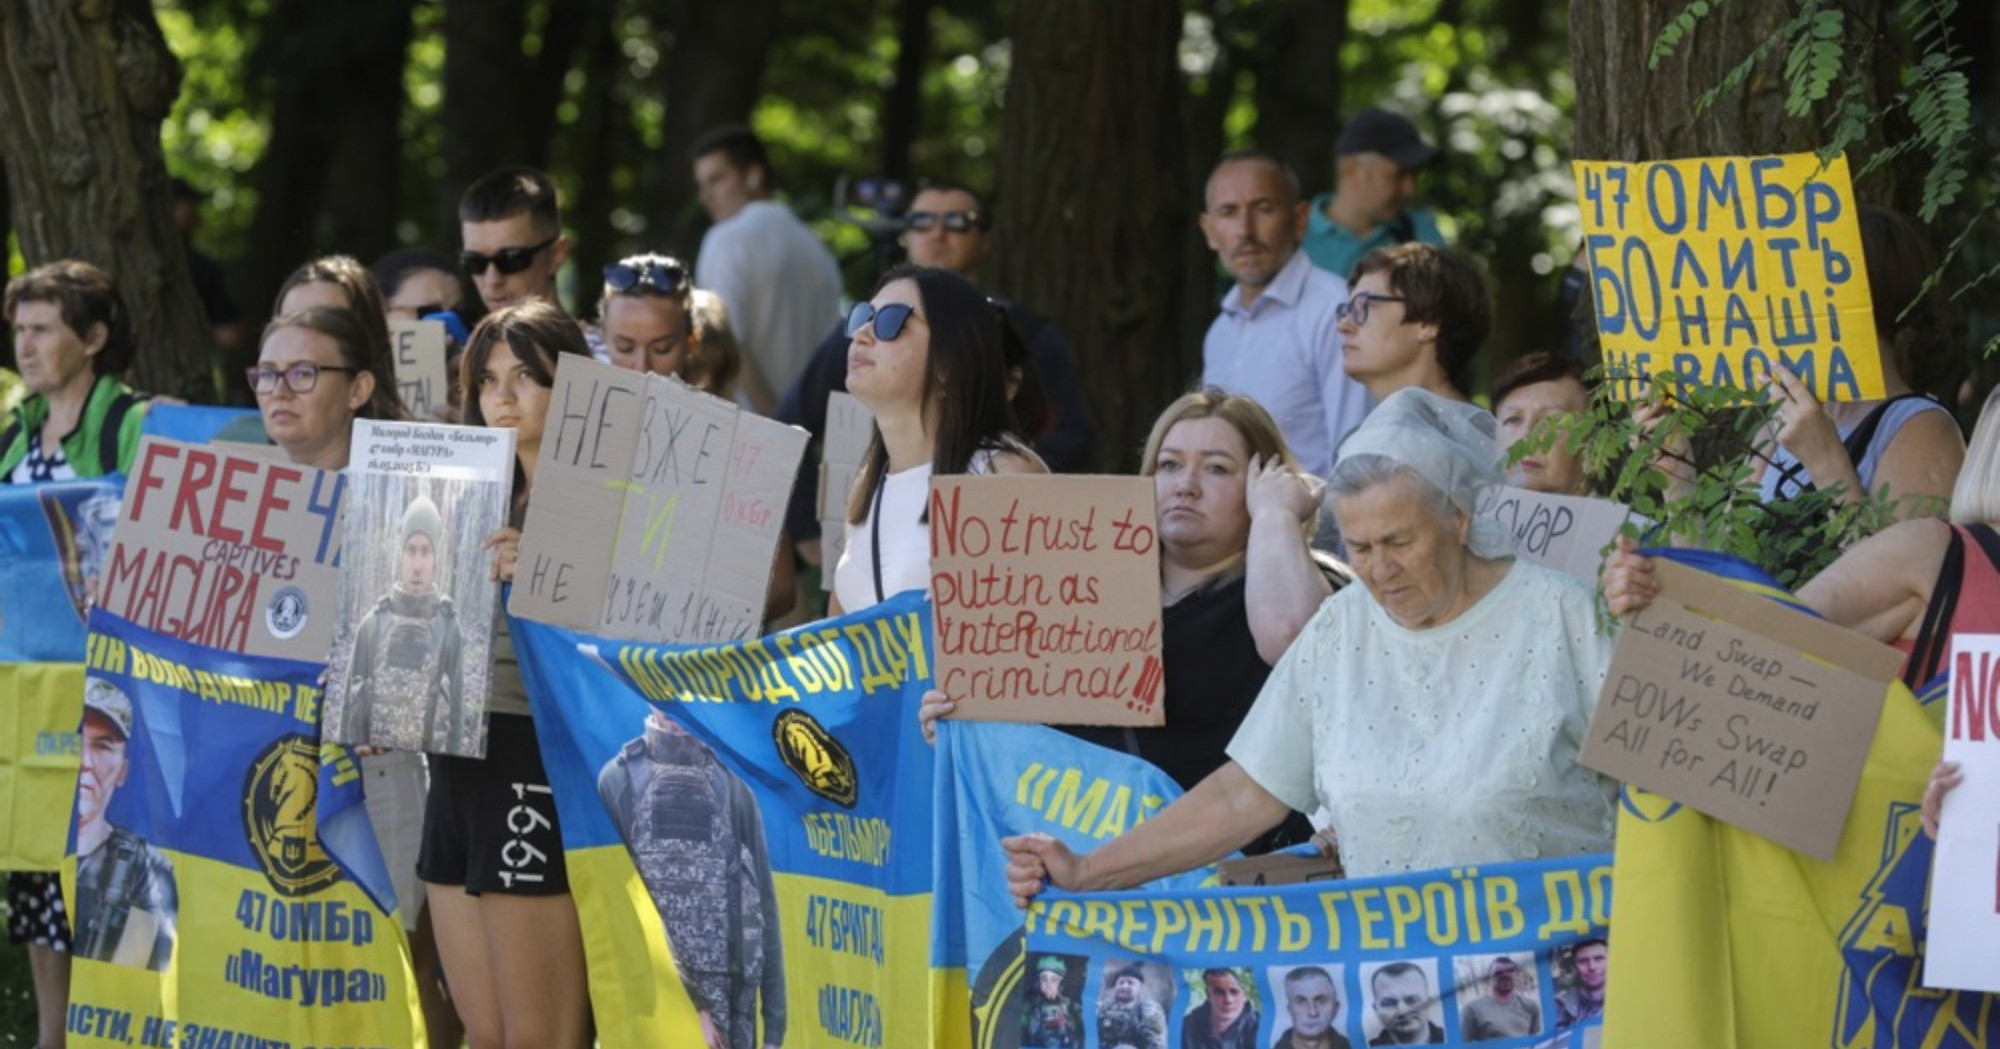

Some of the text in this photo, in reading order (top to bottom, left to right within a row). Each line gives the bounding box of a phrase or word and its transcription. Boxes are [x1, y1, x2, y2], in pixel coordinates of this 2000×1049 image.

[1585, 166, 1630, 230] 47
[130, 443, 302, 554] FREE
[931, 486, 1153, 558] No trust to
[202, 540, 301, 580] CAPTIVES
[529, 555, 574, 603] НЕ
[102, 542, 260, 654] MAGURA
[932, 563, 1099, 637] putin as
[130, 645, 292, 714] ВОЛОДИМИР
[1630, 611, 1706, 651] Land
[1717, 637, 1784, 682] Swap
[1611, 674, 1808, 775] POWs Swap
[1681, 658, 1820, 722] We Demand
[1603, 719, 1777, 807] All for All!
[498, 783, 554, 888] 1991
[235, 889, 264, 931] 47
[807, 894, 827, 947] 47
[1318, 868, 1524, 952] ГЕРОЇВ
[141, 1015, 177, 1049] НЕ
